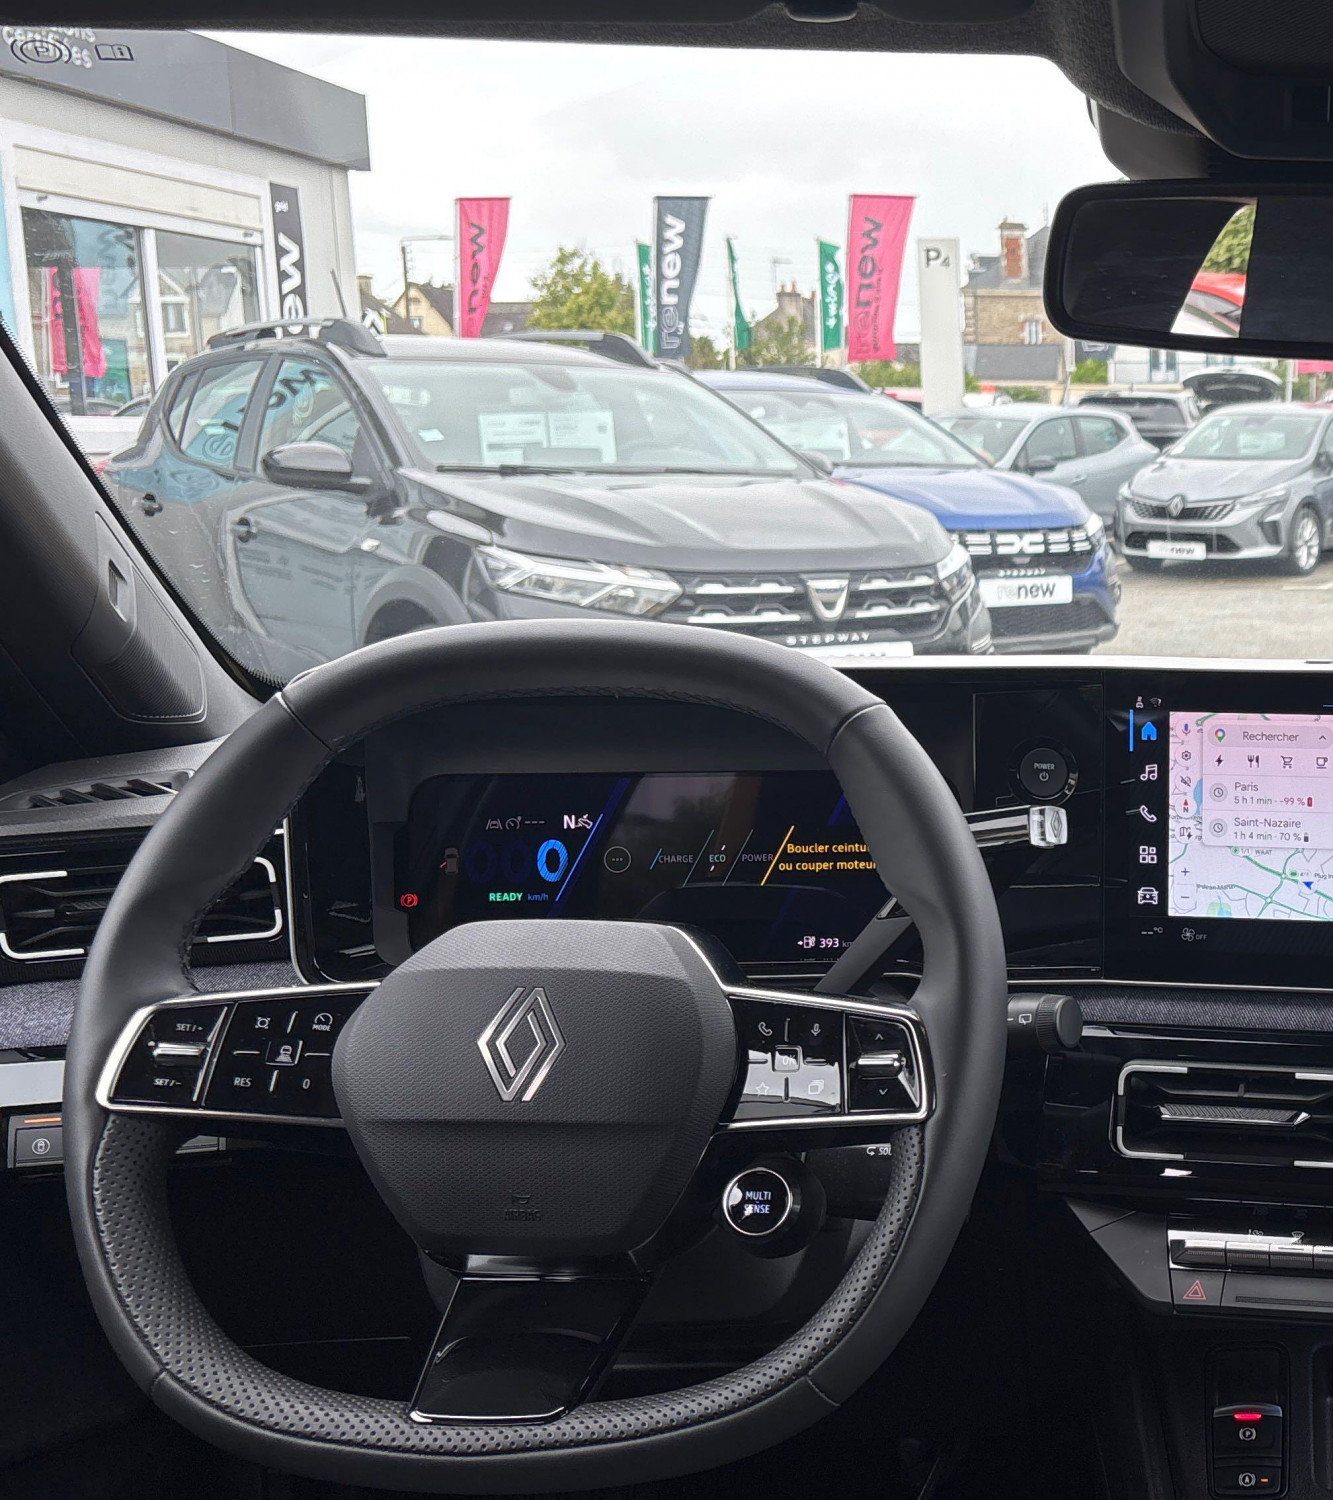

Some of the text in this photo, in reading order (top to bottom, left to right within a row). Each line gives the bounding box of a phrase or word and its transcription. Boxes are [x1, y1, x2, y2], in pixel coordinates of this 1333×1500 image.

[467, 222, 486, 332] new
[661, 214, 685, 349] renew
[855, 216, 883, 354] renew
[786, 632, 869, 646] STEPWAY
[1242, 731, 1299, 743] Rechercher
[1234, 782, 1258, 792] Paris
[1234, 797, 1239, 805] 5
[1242, 797, 1248, 805] h
[1256, 797, 1272, 805] min
[1279, 797, 1295, 805] -99
[563, 815, 575, 829] N
[1234, 818, 1301, 828] Saint-Nazaire
[1234, 832, 1238, 840] 1
[1240, 832, 1246, 840] h
[1250, 832, 1255, 840] 4
[1257, 832, 1272, 840] min
[1279, 832, 1291, 841] 70
[787, 843, 870, 854] Boucler ceintu
[658, 855, 694, 863] CHARGE
[709, 854, 726, 863] ECO
[742, 854, 774, 862] POWER
[779, 862, 791, 870] ou
[796, 861, 833, 872] couper
[489, 893, 549, 901] READY km/h
[819, 938, 840, 948] 393
[781, 1055, 796, 1065] OK
[233, 1077, 252, 1086] RES
[745, 1191, 772, 1200] MULTI
